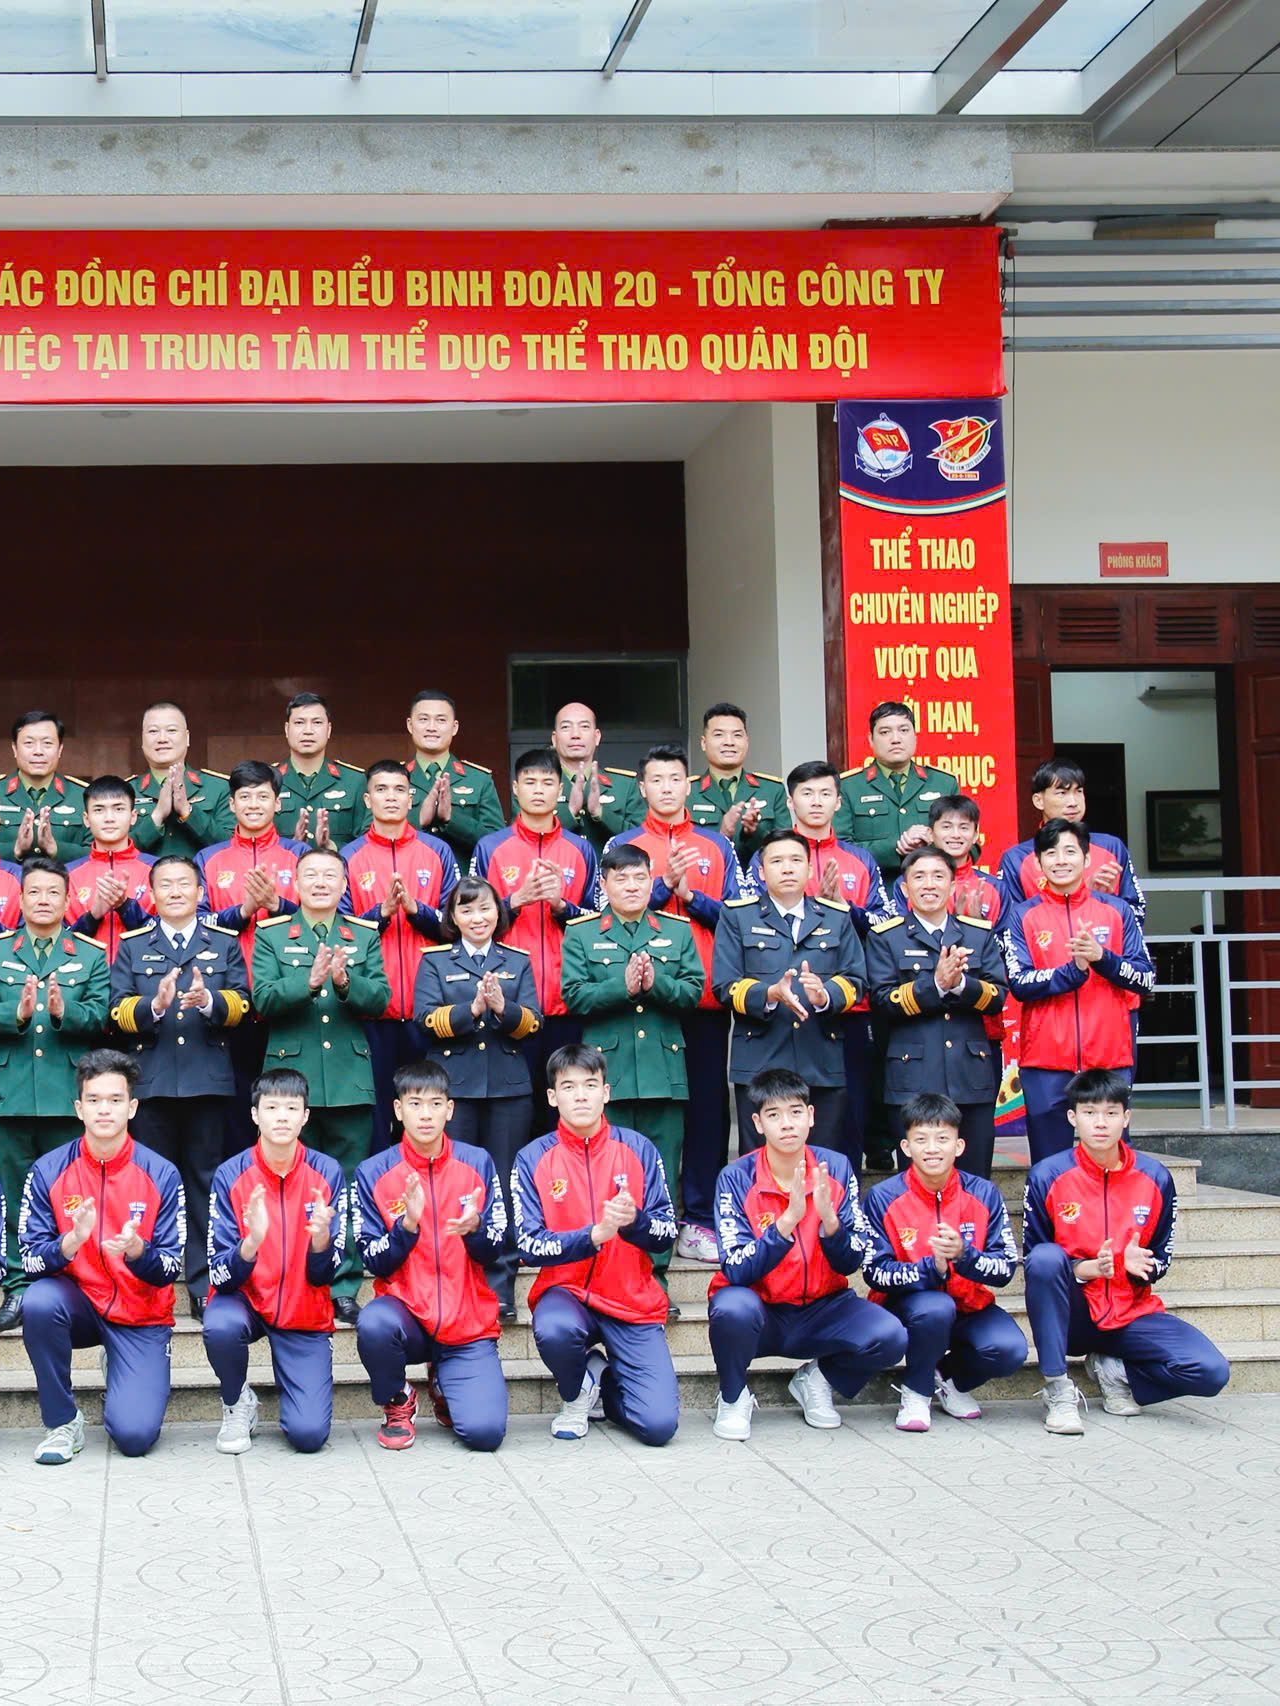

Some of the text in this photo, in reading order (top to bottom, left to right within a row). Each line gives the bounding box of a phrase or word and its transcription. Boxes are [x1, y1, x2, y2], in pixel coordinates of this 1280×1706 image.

[55, 258, 155, 306] ĐỒNG
[169, 262, 228, 306] CHÍ
[239, 270, 299, 314] ĐẠI
[313, 256, 393, 306] BIỂU
[407, 271, 492, 306] BINH
[504, 263, 602, 306] ĐOÀN
[615, 271, 656, 307] 20
[669, 287, 681, 296] -
[692, 257, 785, 306] TỔNG
[798, 263, 893, 306] CÔNG
[904, 269, 944, 304] TY
[73, 334, 128, 379] TẠI
[141, 334, 259, 371] TRUNG
[272, 328, 350, 371] TÂM
[361, 319, 429, 371] THỂ
[440, 334, 510, 379] DỤC
[521, 319, 588, 371] THỂ
[598, 334, 688, 371] THAO
[701, 326, 797, 375] QUÂN
[809, 326, 867, 377] ĐỘI
[872, 432, 899, 447] SNP
[870, 526, 975, 569] THỂ THAO
[1107, 552, 1161, 569] PHÒNG KHÁCH
[850, 586, 999, 630] CHUYÊN NGHIỆP
[874, 644, 978, 685] VƯỢT QUA
[927, 701, 979, 740] HẠN,
